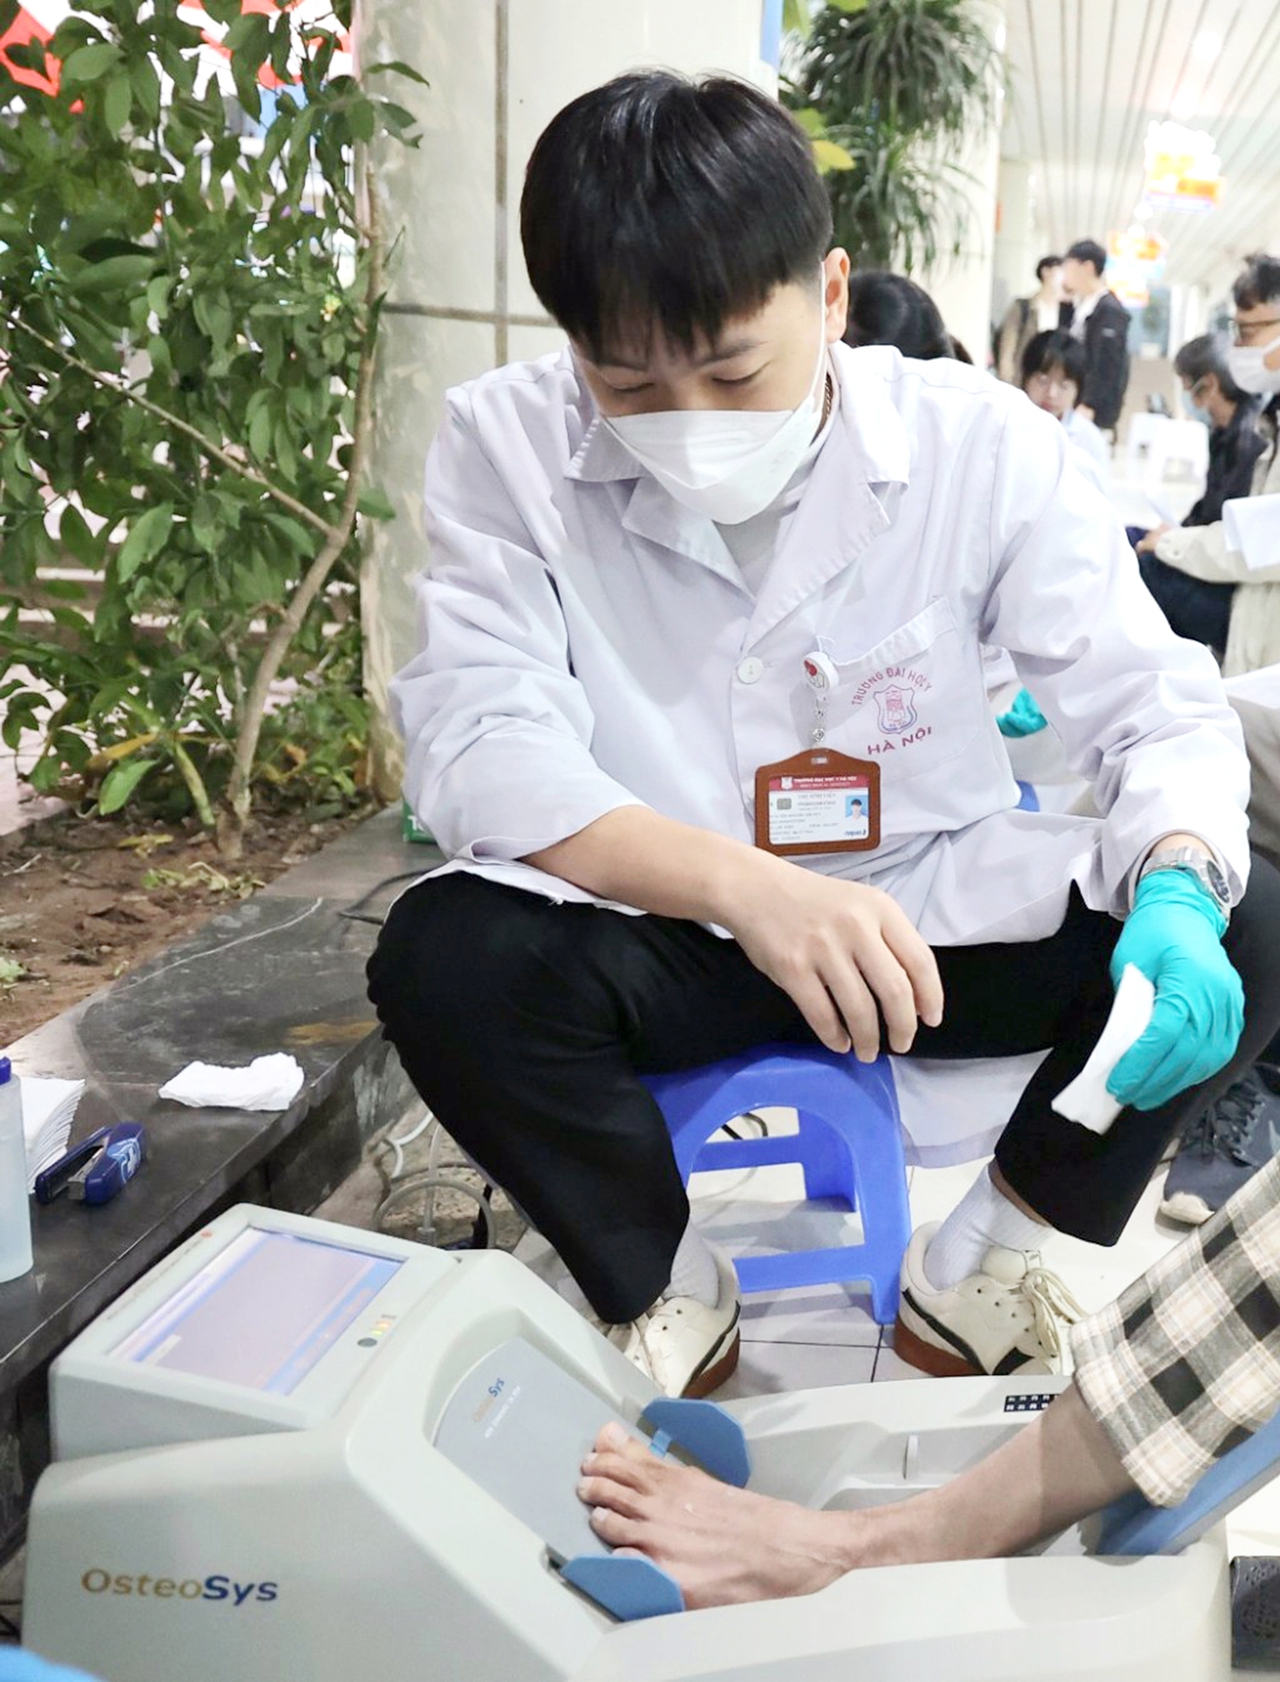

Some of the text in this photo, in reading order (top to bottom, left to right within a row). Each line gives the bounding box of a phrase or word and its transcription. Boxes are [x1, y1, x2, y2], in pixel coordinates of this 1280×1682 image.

[867, 726, 932, 755] HÀ NỘI
[80, 1568, 279, 1607] OsteoSys
